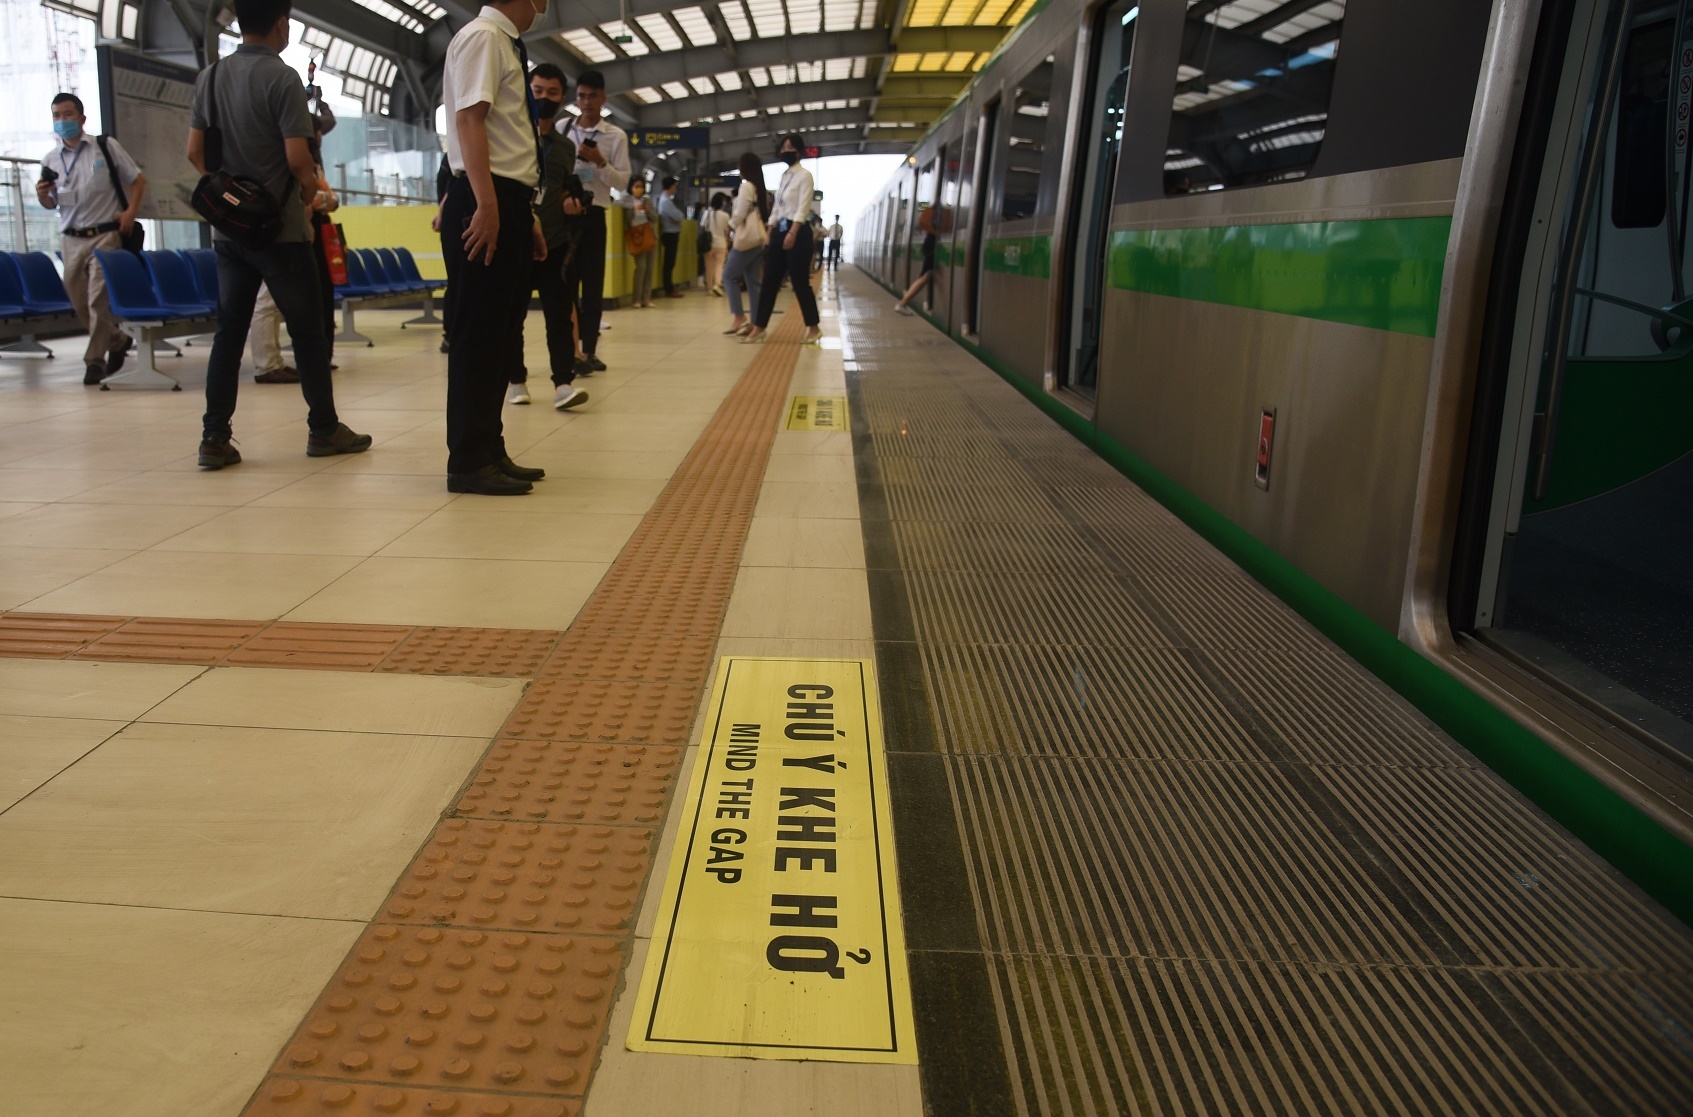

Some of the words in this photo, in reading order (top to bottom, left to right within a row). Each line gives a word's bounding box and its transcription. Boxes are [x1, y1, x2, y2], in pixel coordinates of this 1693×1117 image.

[783, 683, 845, 742] CHÚ
[725, 723, 761, 771] MIND
[782, 753, 847, 775] Ý
[715, 778, 754, 820] THE
[704, 827, 748, 884] GAP
[774, 787, 837, 873] KHE
[766, 893, 872, 980] HỞ
